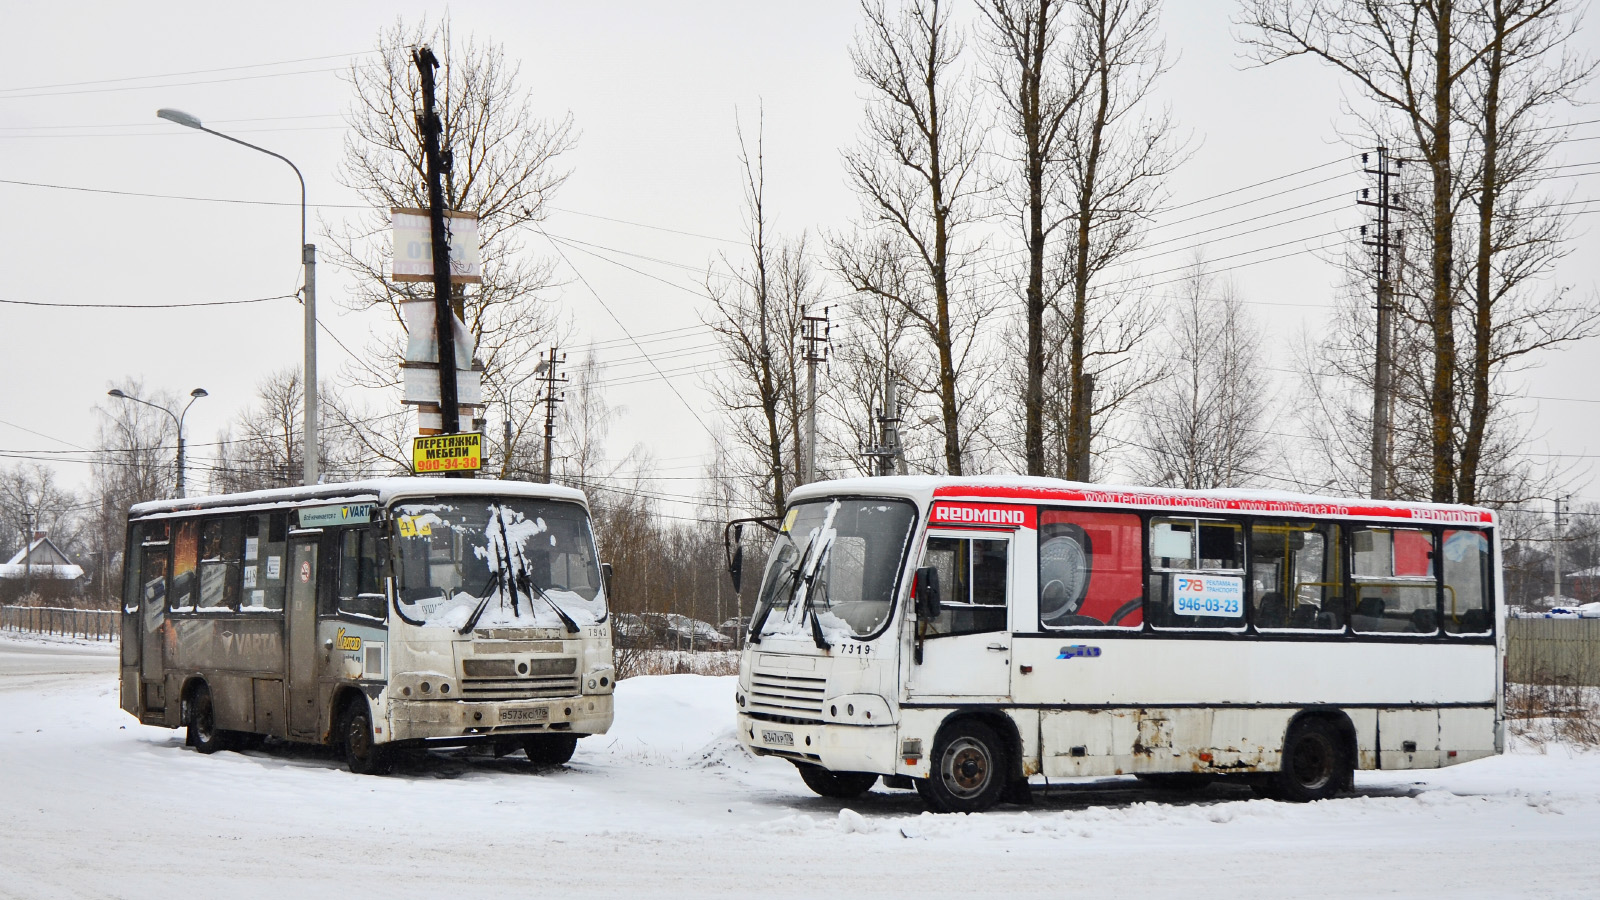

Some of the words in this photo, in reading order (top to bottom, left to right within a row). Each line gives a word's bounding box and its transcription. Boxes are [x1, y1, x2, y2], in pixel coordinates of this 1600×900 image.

[416, 436, 479, 449] ПЕРЕТЯЖКА
[426, 447, 469, 460] МЕБЕЛИ
[417, 457, 478, 471] 900-34-38
[1206, 586, 1239, 594] ТРАНСПОРТЕ
[1178, 597, 1239, 613] 946-03-23
[841, 644, 870, 655] 7319
